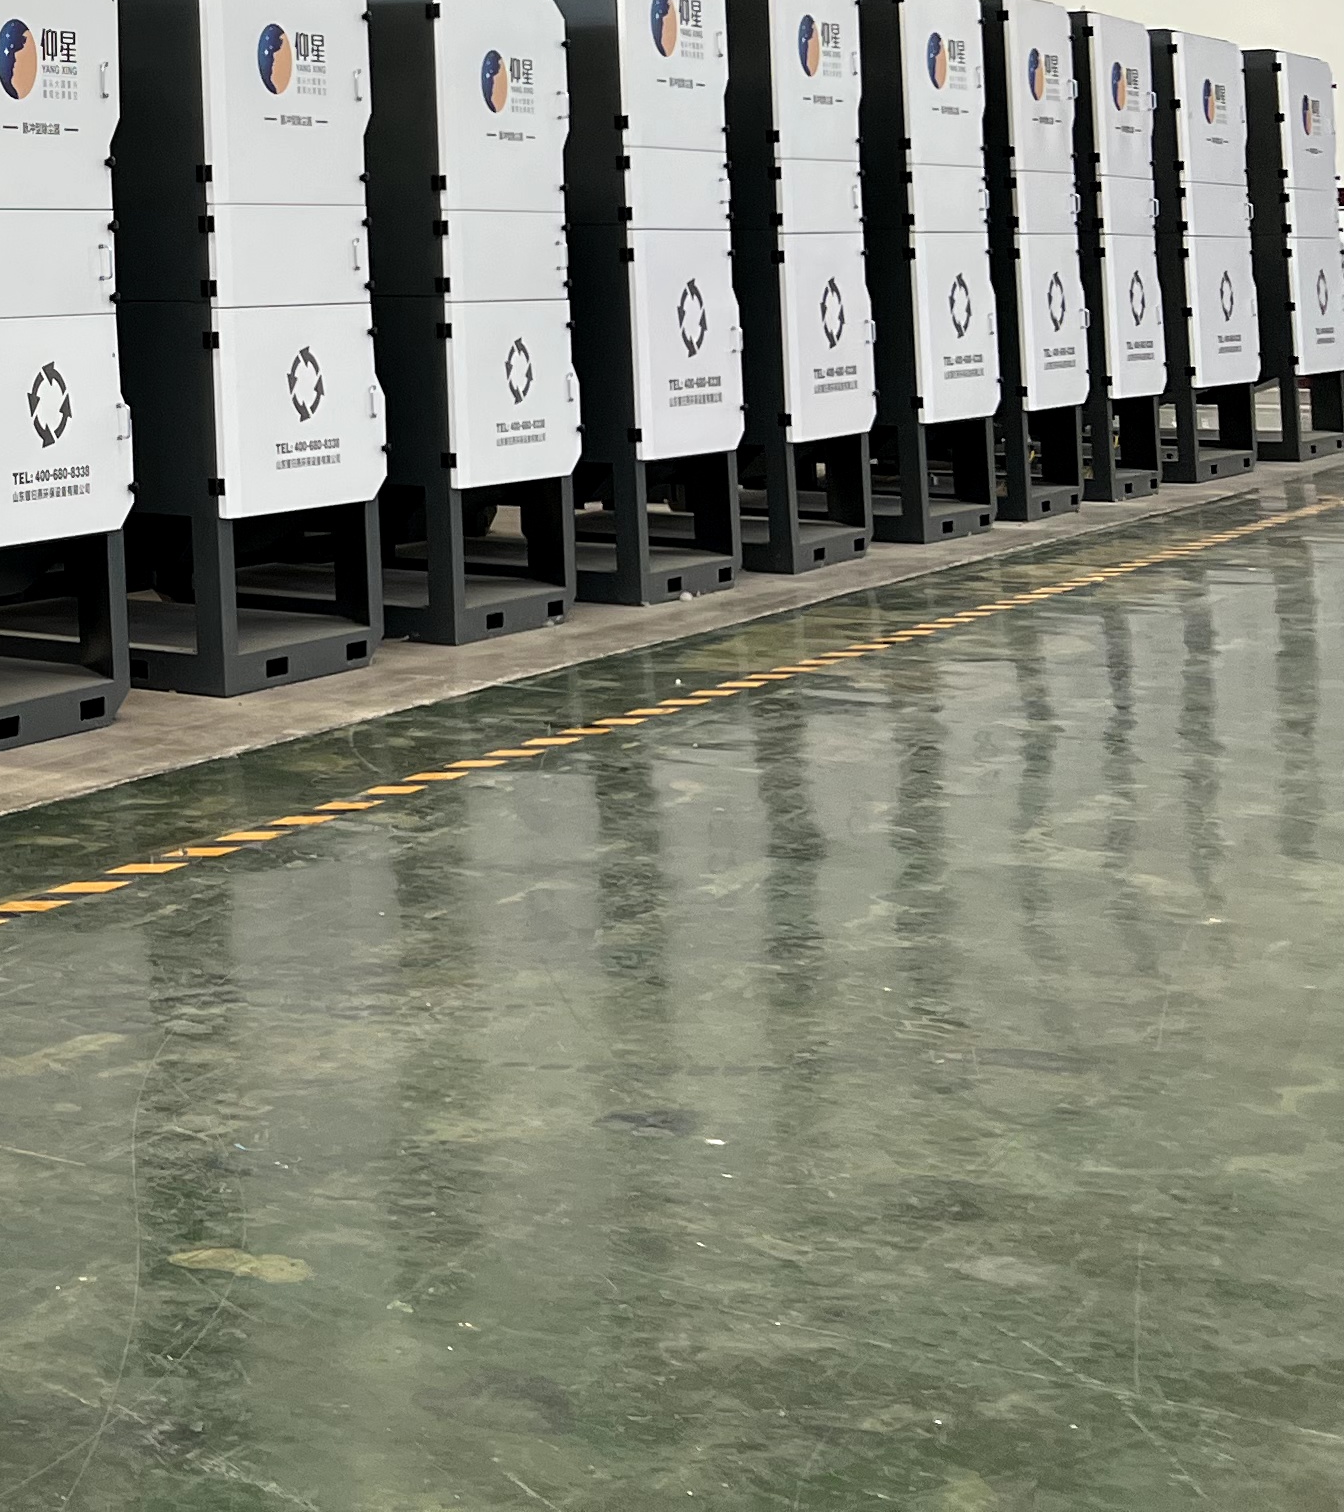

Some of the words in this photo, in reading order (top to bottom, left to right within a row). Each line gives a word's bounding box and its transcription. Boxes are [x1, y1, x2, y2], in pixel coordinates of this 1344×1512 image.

[40, 28, 77, 63] 仰星
[42, 65, 60, 75] YANG
[13, 472, 33, 485] TEL:
